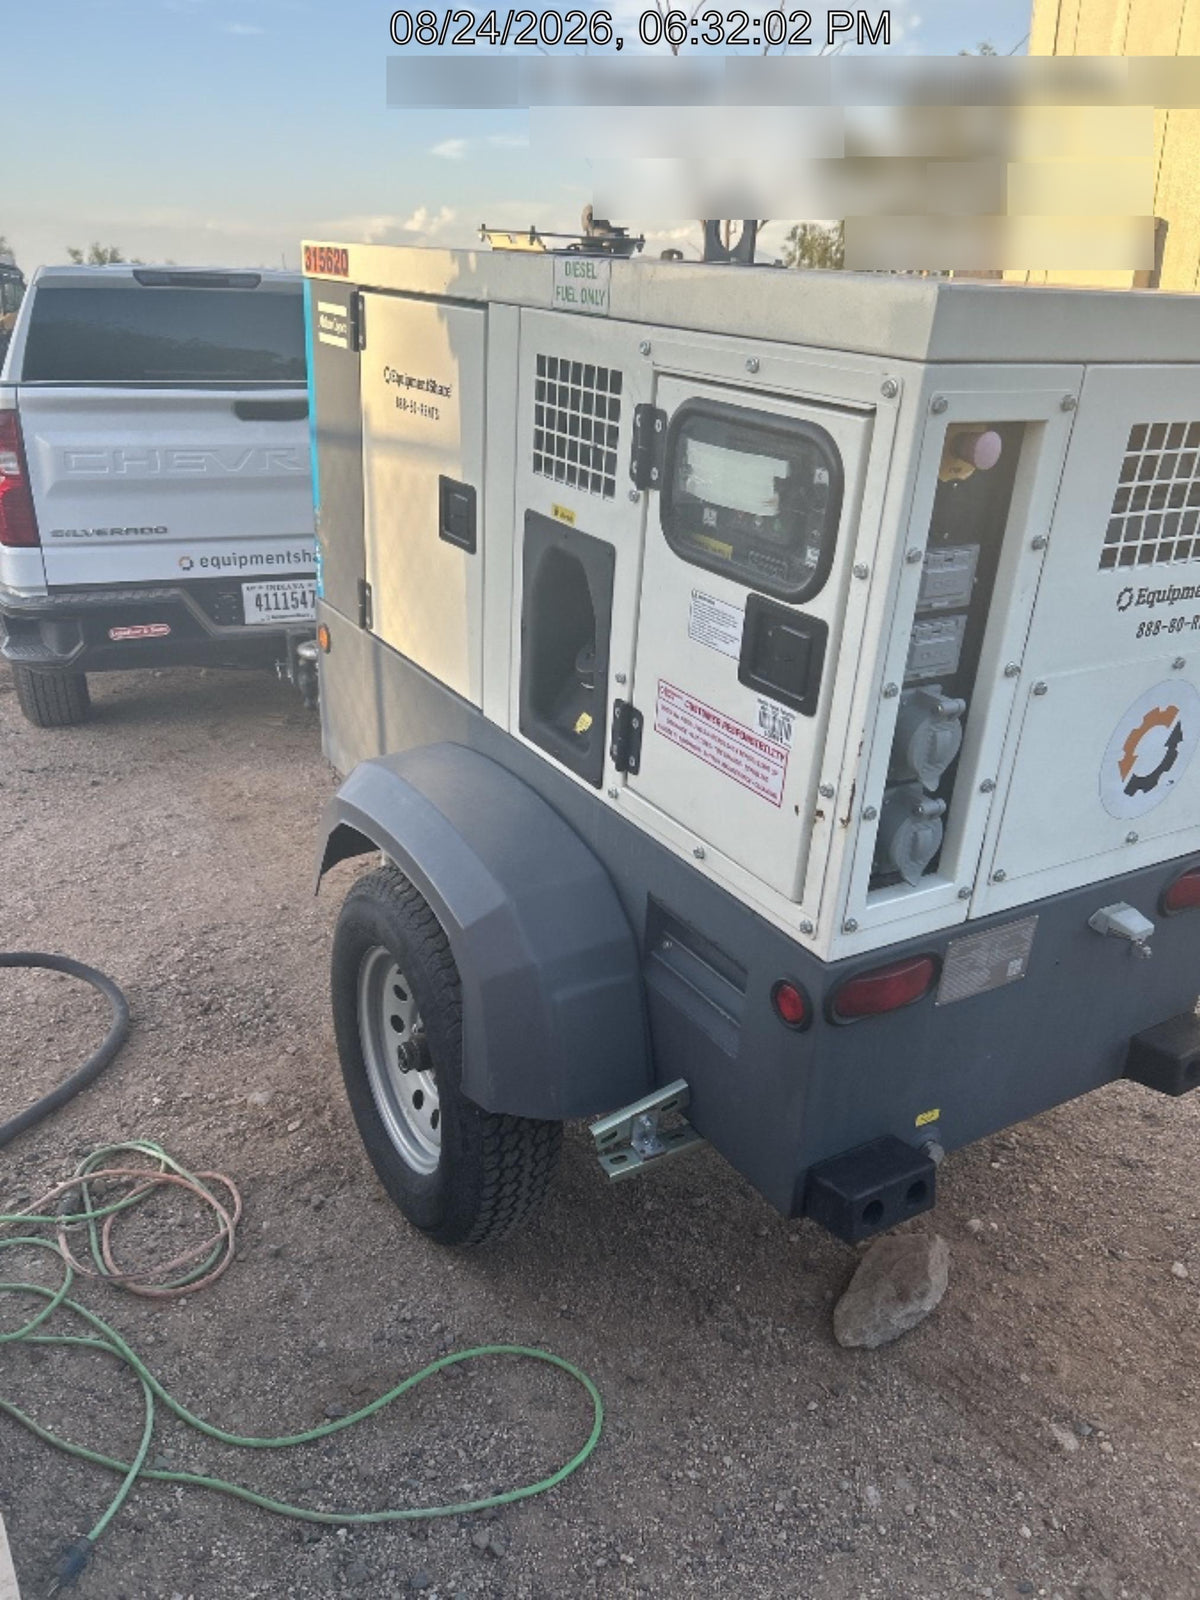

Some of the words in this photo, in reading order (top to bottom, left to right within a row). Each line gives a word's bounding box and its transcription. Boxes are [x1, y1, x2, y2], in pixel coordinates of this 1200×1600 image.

[304, 245, 349, 277] 315620
[565, 261, 597, 279] DIESEL
[556, 285, 578, 303] FUEL
[581, 287, 606, 306] ONLY
[64, 446, 306, 475] CHEVR
[51, 525, 168, 538] SILVERADO
[266, 583, 305, 591] INDIANA
[255, 590, 316, 611] 4111547
[1136, 614, 1200, 639] 888-80-R
